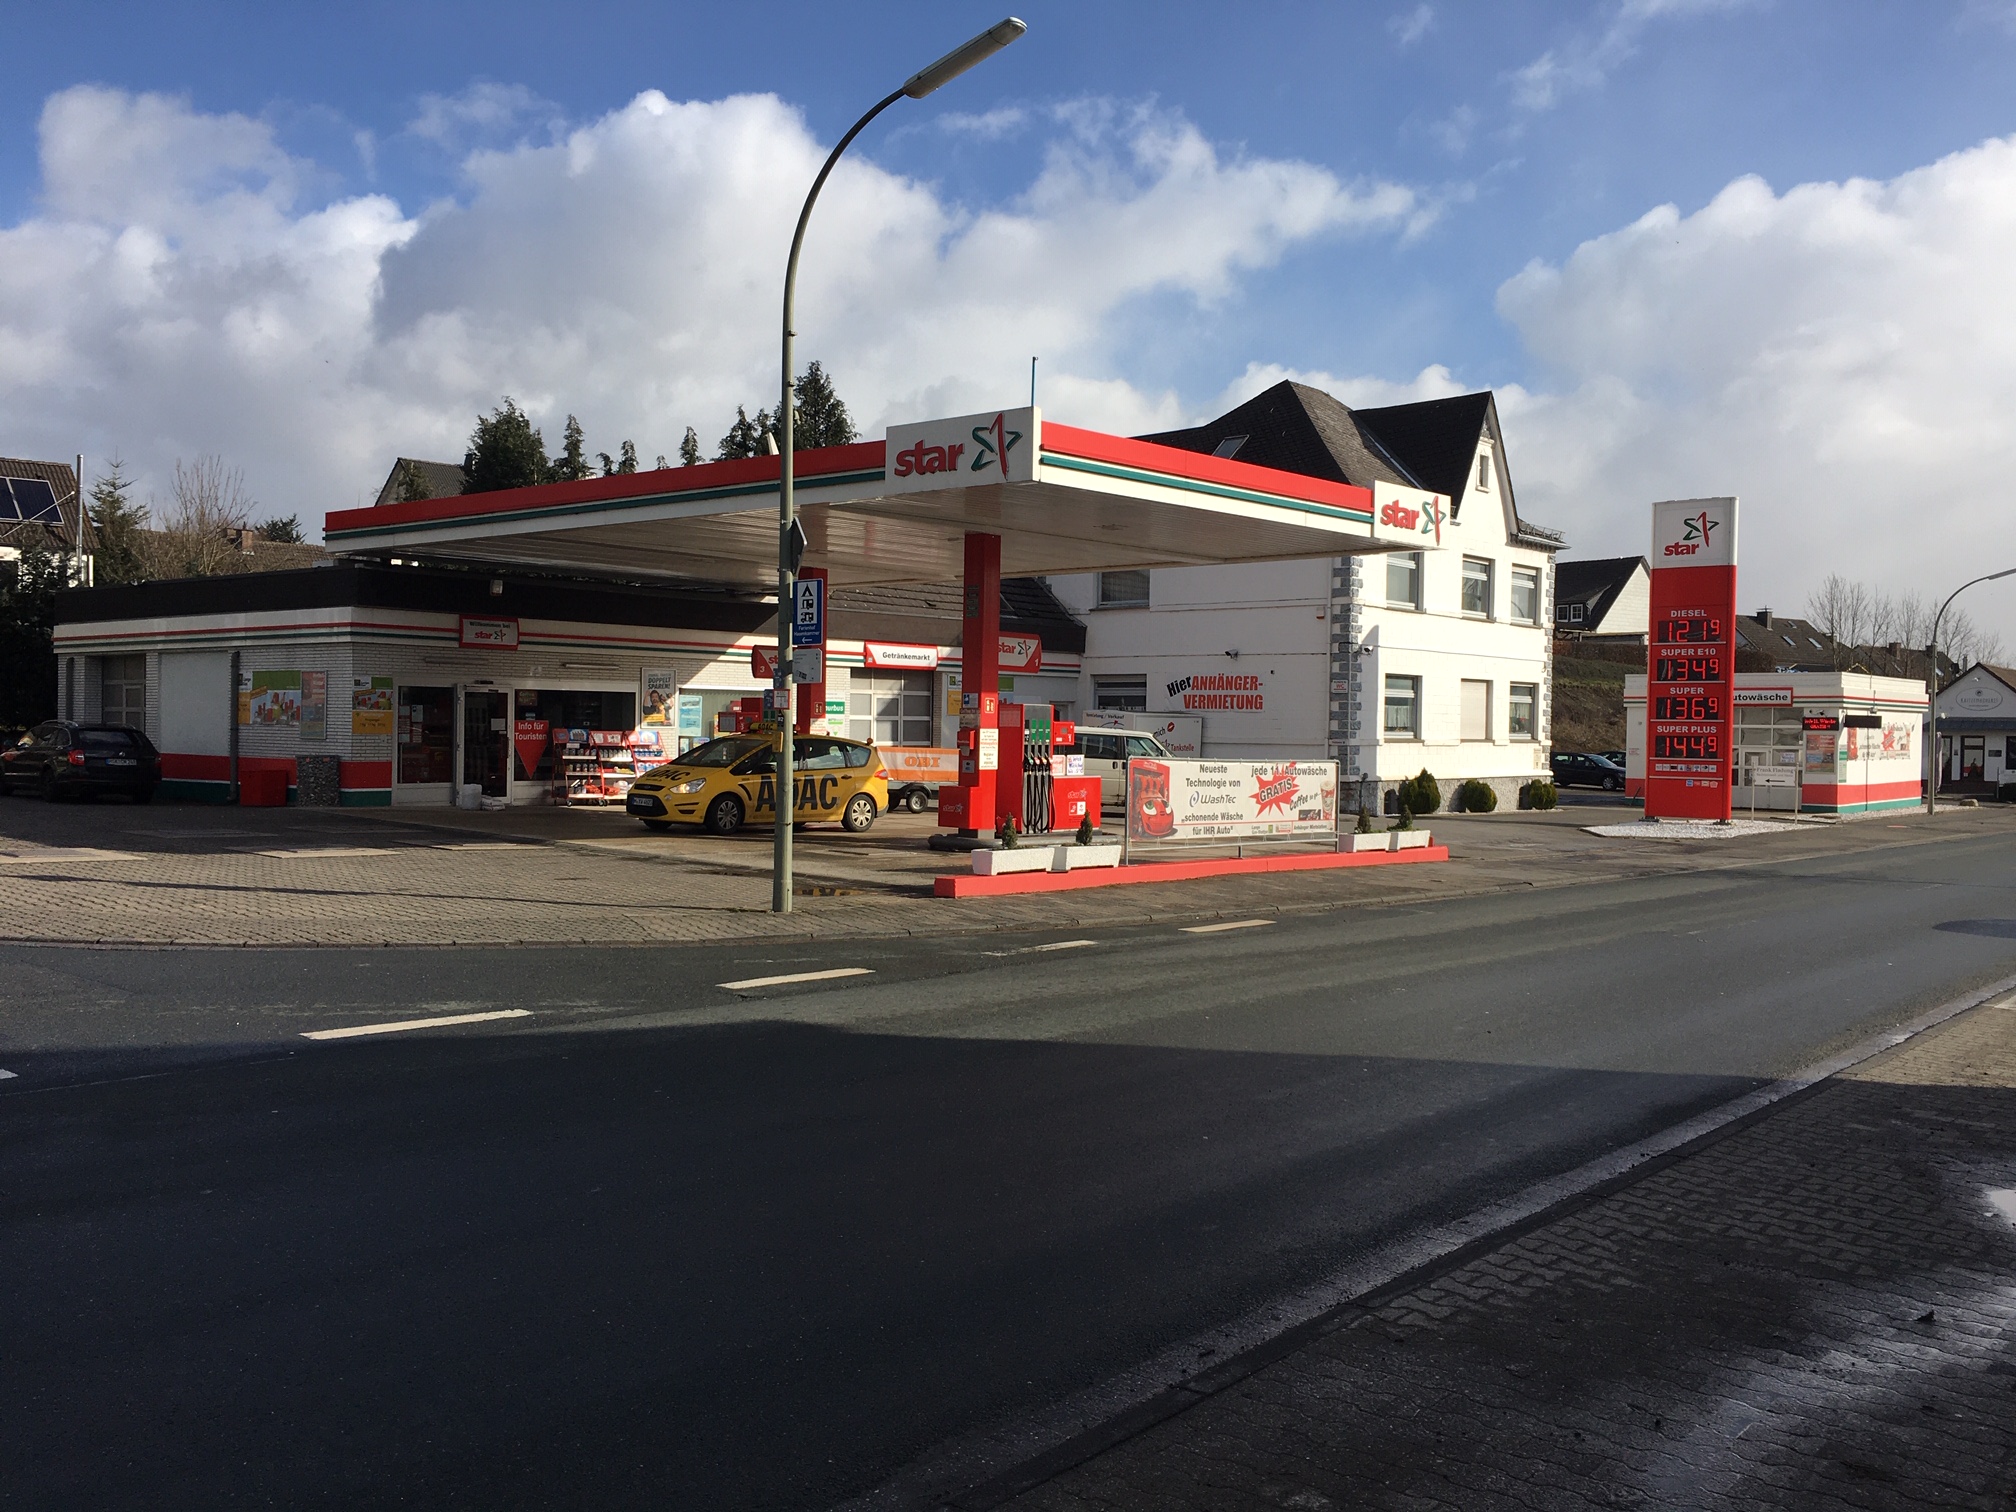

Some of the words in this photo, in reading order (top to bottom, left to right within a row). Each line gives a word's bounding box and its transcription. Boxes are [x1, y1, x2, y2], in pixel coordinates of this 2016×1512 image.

[894, 440, 965, 477] star
[1380, 499, 1419, 530] star
[1664, 542, 1699, 556] star
[474, 630, 493, 639] star
[882, 651, 931, 661] Getränkemarkt
[1661, 648, 1695, 656] SUPER
[1697, 648, 1717, 656] E10
[1034, 659, 1039, 667] 1
[759, 665, 765, 673] 3
[1166, 675, 1192, 697] Hier
[1191, 673, 1264, 691] ANHÄNGER-
[1670, 687, 1705, 695] SUPER
[1733, 693, 1788, 701] utowäsche
[1183, 694, 1264, 710] VERMIETUNG
[518, 722, 532, 730] Info
[533, 722, 544, 730] für
[757, 723, 774, 731] ADAC
[1656, 725, 1689, 733] SUPER
[514, 732, 547, 740] Touristen
[1171, 743, 1195, 752] Tankstelle
[904, 756, 941, 768] OBI
[1199, 764, 1228, 774] Neueste
[1251, 765, 1268, 777] jede
[1270, 765, 1282, 776] 11.
[1284, 764, 1328, 776] Autowäsche
[1185, 778, 1227, 789] Technologie
[1228, 779, 1241, 787] von
[1259, 778, 1293, 802] GRATIS
[1200, 794, 1237, 804] WashTec
[1220, 812, 1244, 821] Wäsche
[1192, 827, 1202, 835] für
[1203, 827, 1215, 835] IHR
